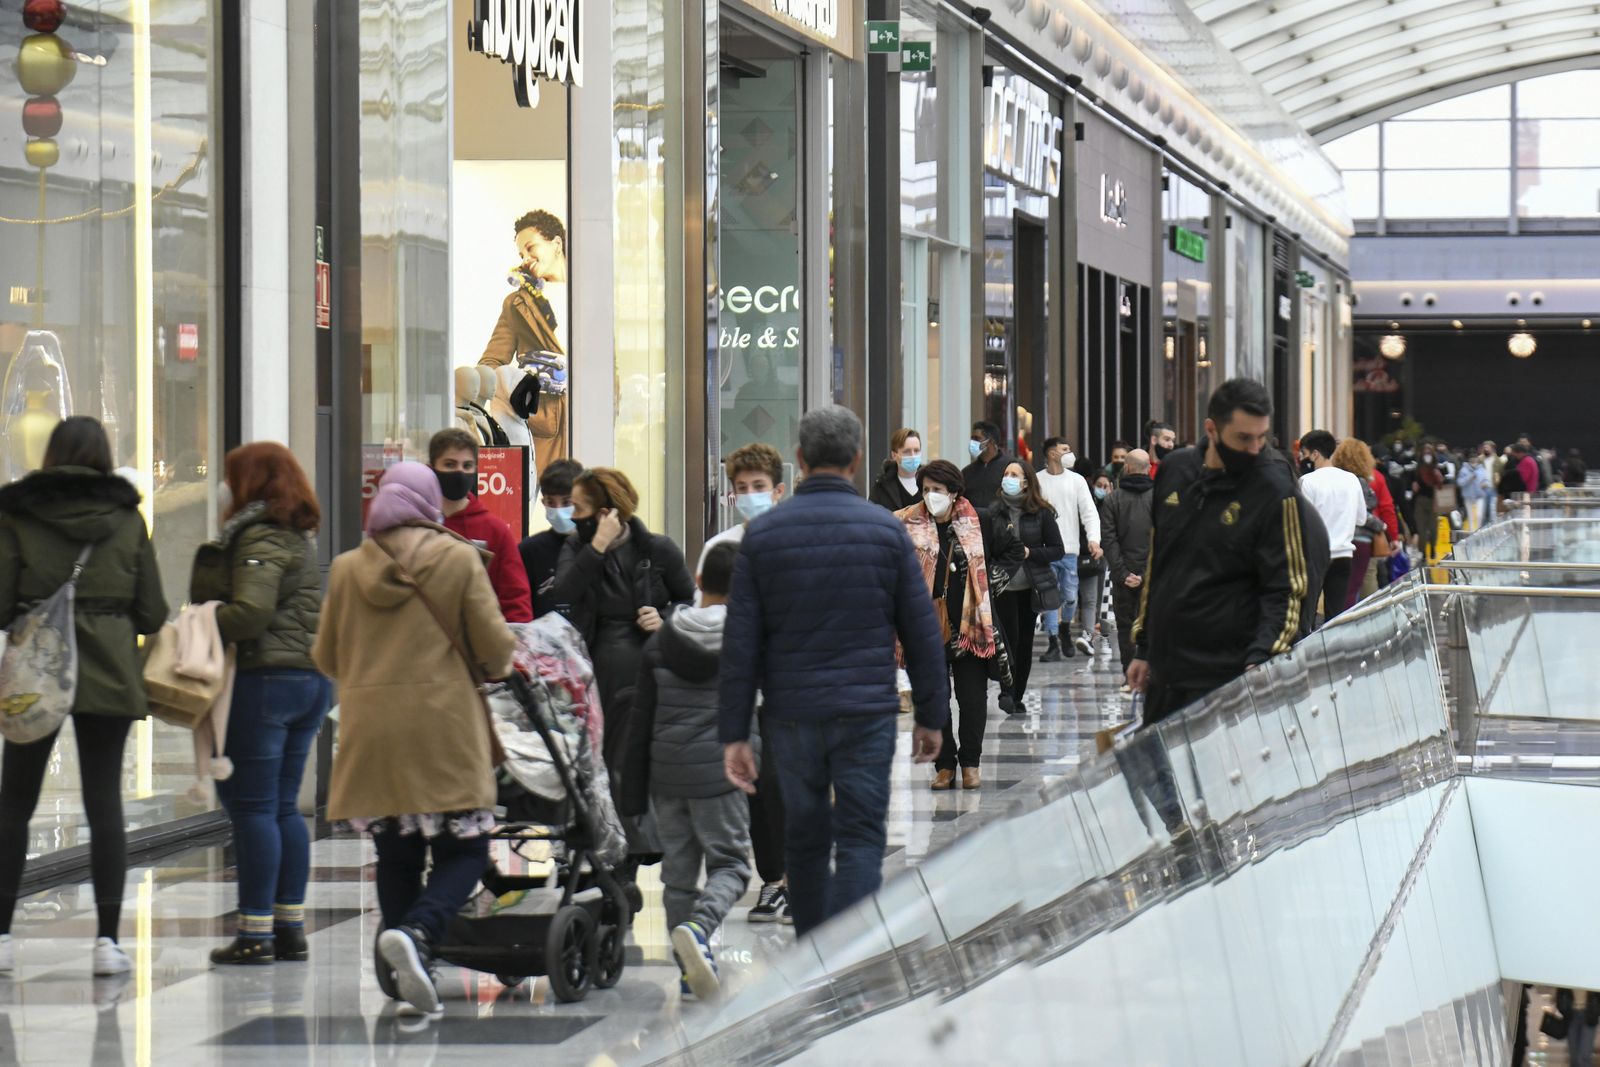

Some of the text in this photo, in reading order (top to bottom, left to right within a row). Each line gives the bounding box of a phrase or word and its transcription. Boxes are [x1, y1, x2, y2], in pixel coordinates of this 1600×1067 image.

[719, 285, 800, 314] ecr
[757, 326, 778, 349] &
[783, 326, 800, 349] S
[477, 472, 514, 495] 50%
